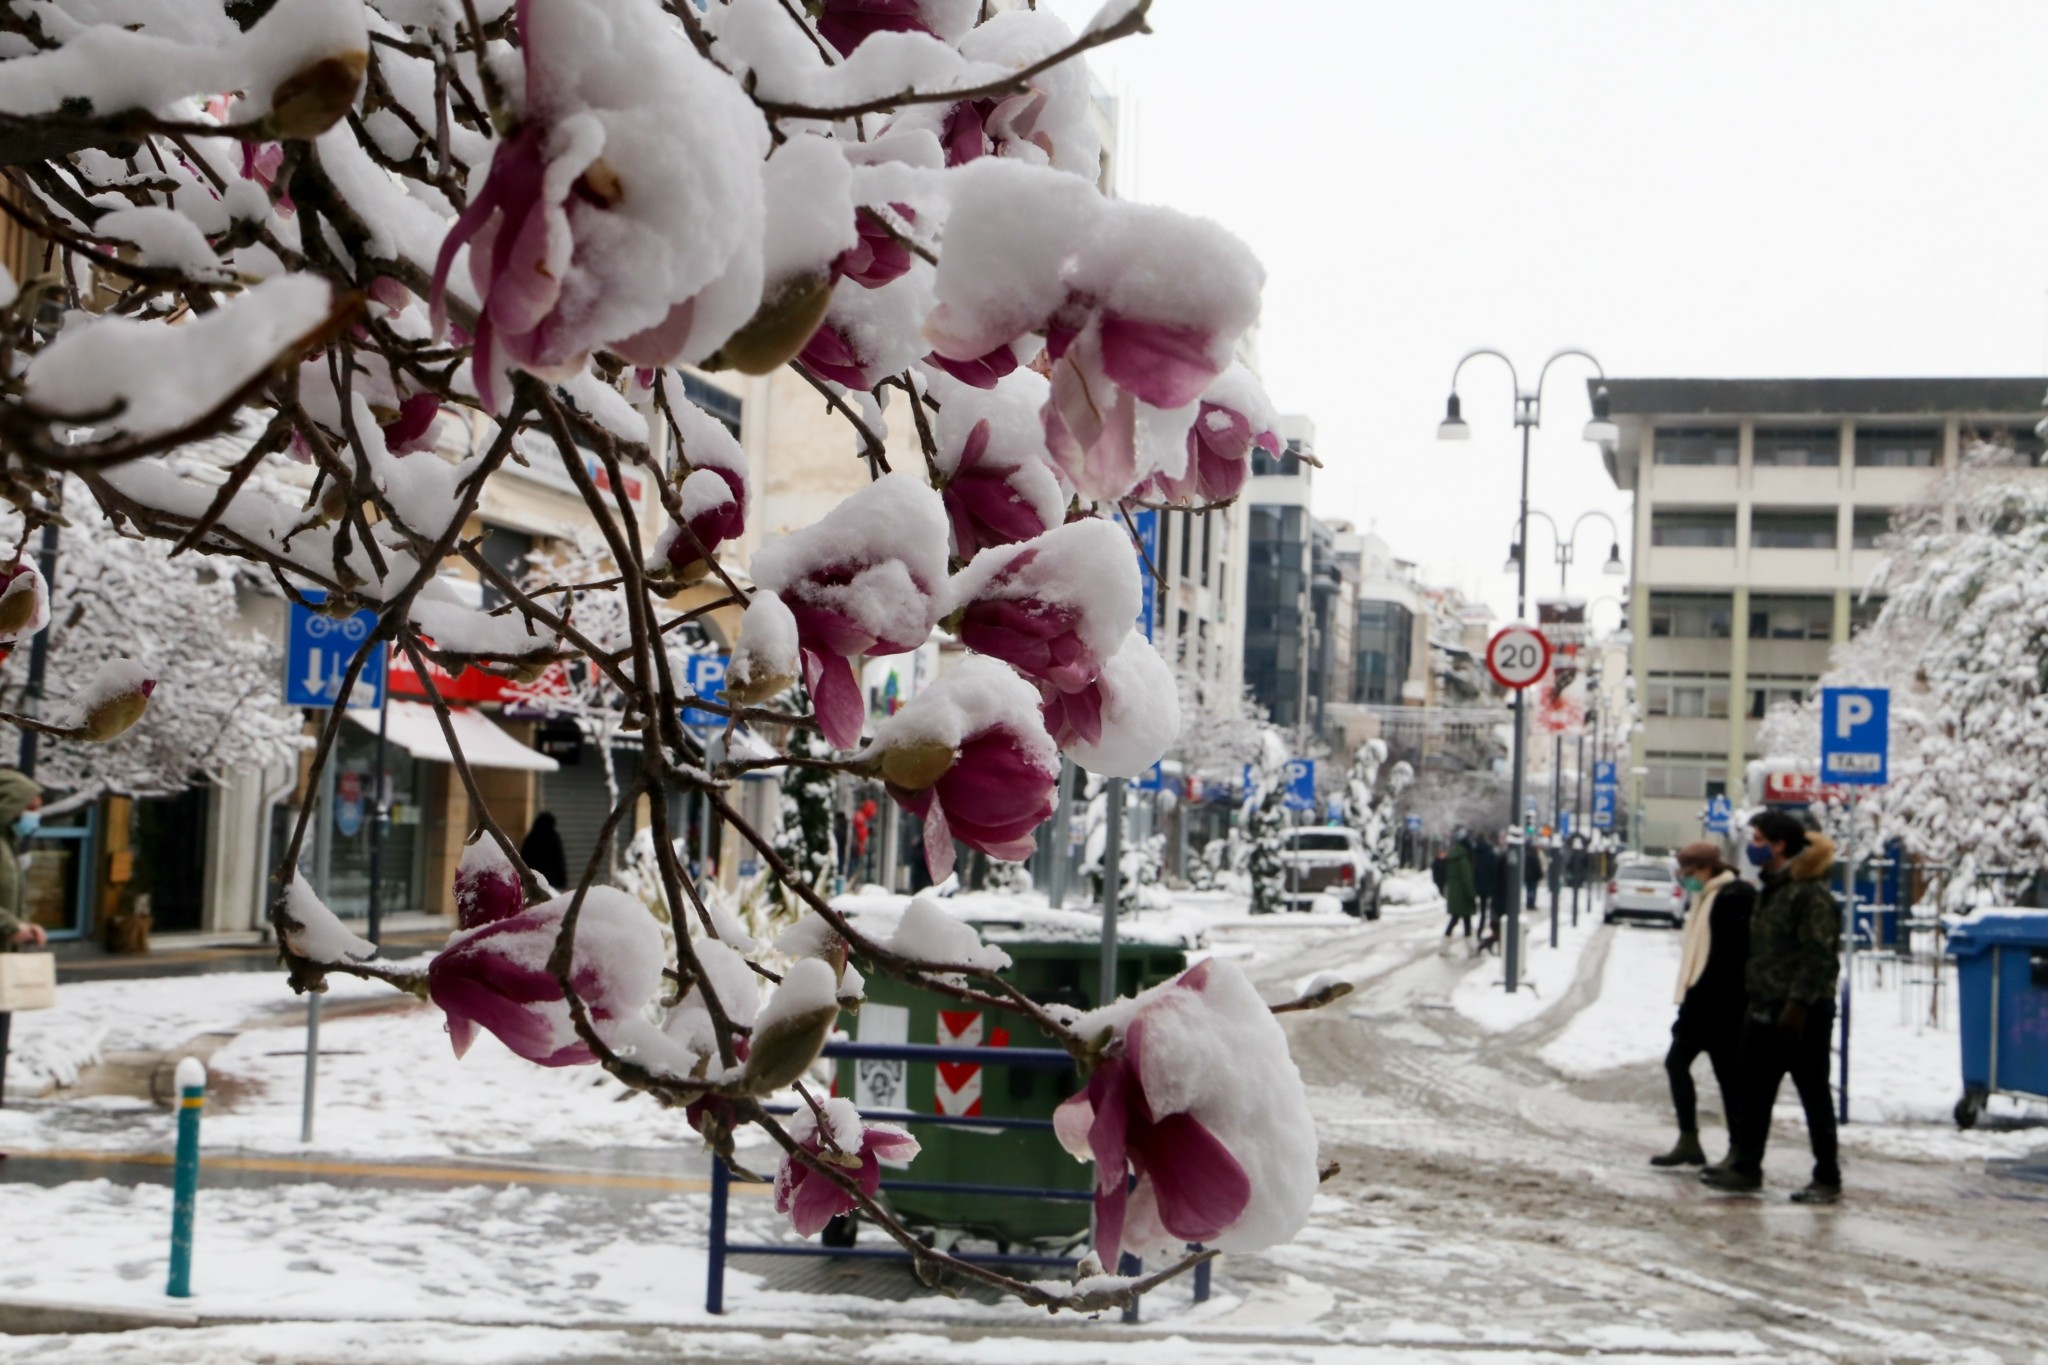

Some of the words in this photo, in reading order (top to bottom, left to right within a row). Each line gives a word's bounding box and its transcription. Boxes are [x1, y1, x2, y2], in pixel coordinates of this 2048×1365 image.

[1500, 643, 1537, 669] 20
[696, 660, 724, 692] P
[1836, 694, 1873, 738] P
